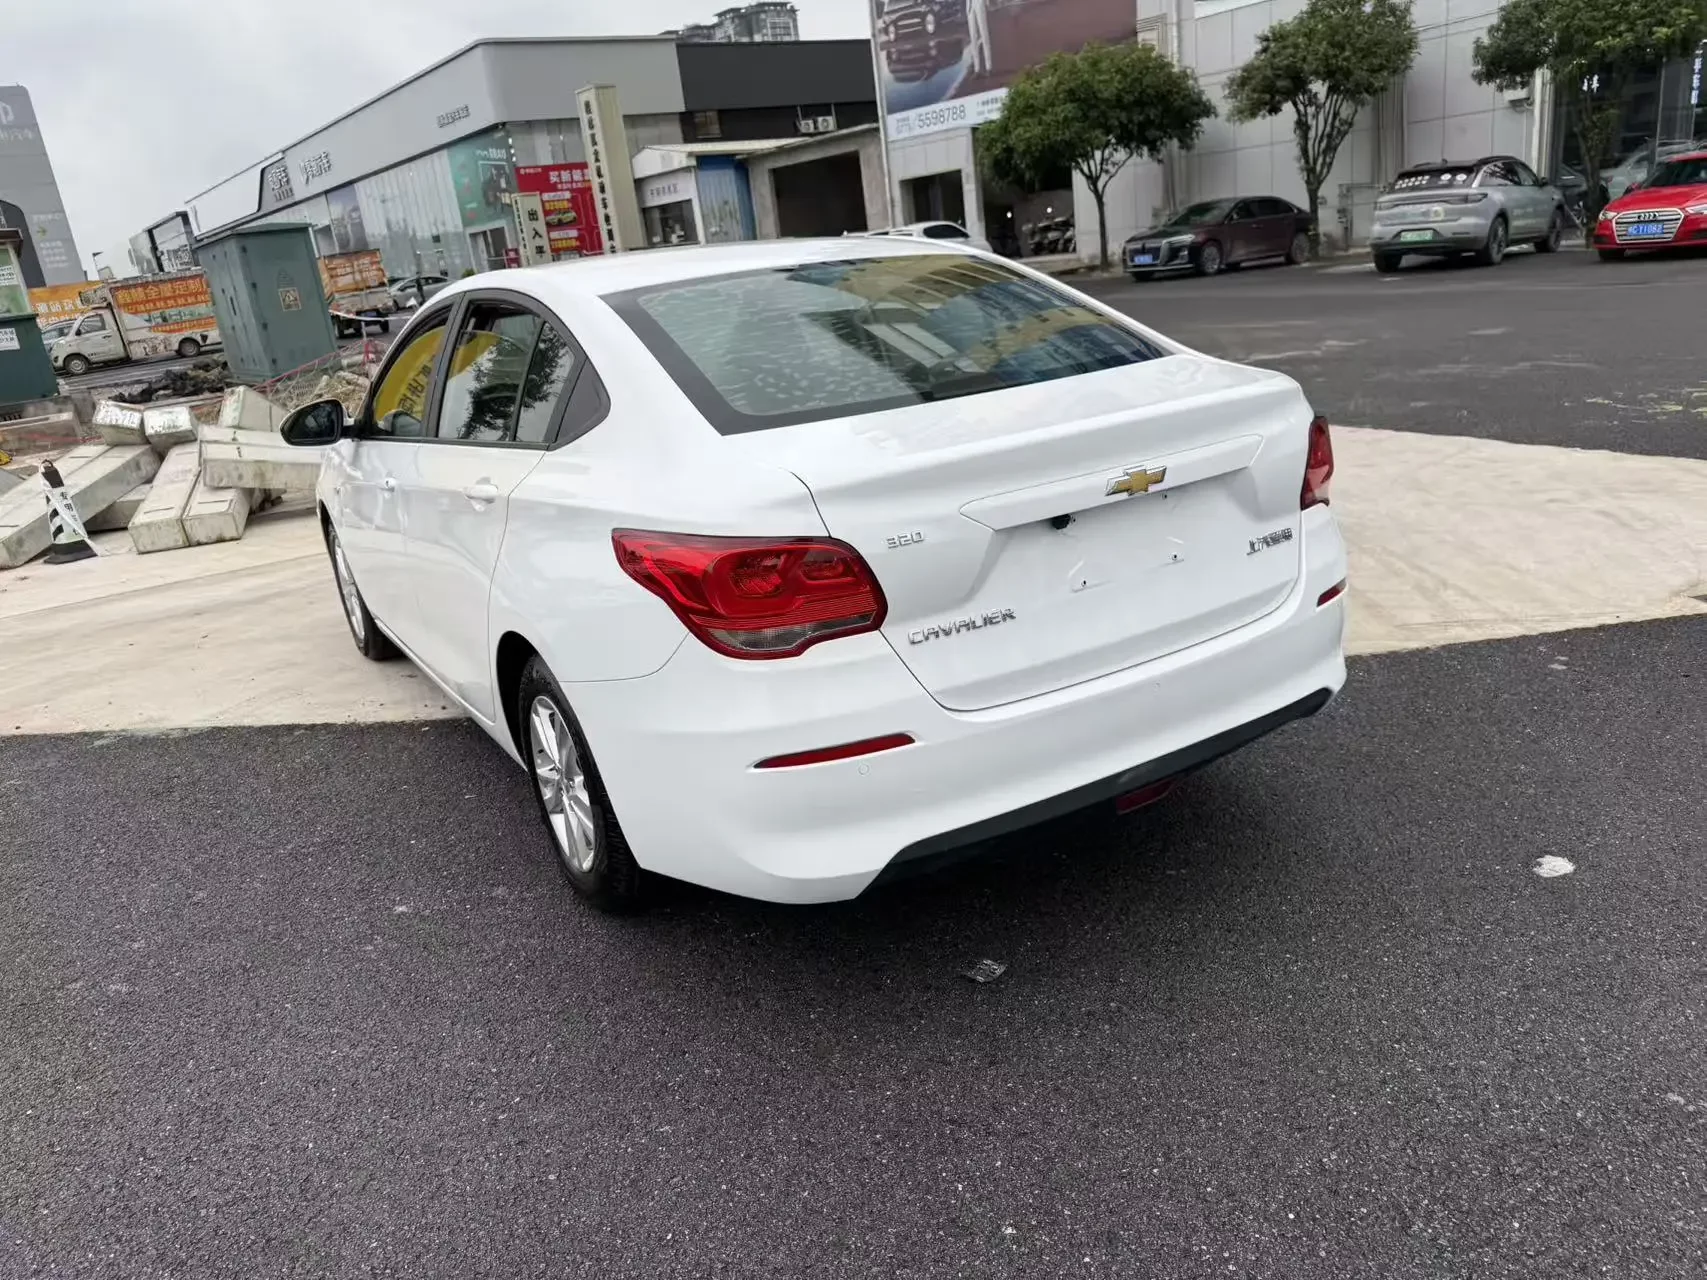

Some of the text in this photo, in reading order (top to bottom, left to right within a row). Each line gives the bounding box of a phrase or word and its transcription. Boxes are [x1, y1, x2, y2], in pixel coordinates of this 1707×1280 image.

[918, 104, 967, 129] 5598788
[884, 532, 925, 550] 320
[908, 607, 1016, 646] CAVALIER
